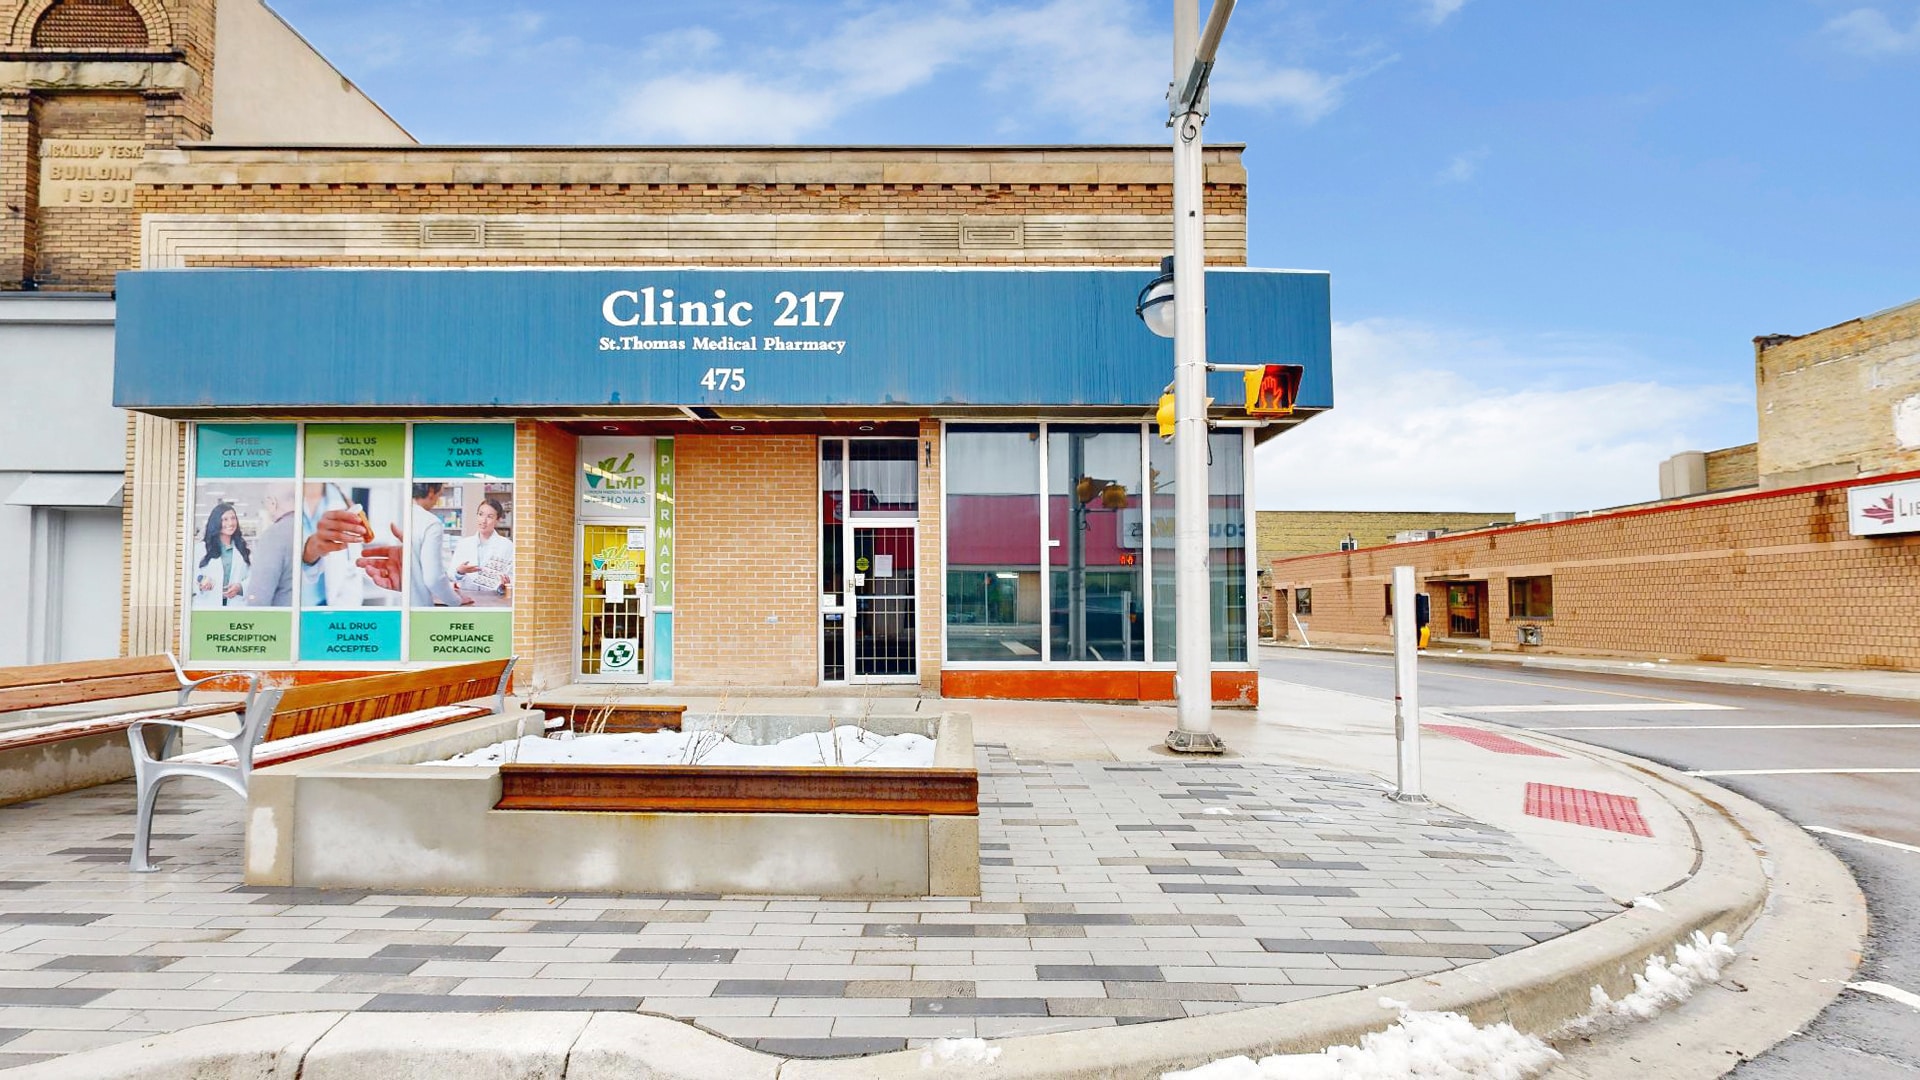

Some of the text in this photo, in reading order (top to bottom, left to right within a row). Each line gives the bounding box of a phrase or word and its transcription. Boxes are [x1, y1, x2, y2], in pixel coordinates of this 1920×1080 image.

[50, 166, 133, 181] BUILDIN
[602, 286, 845, 327] Clinic 217
[692, 336, 757, 351] Medical
[763, 336, 846, 355] Pharmacy
[700, 367, 746, 392] 475
[235, 437, 261, 445] FREE
[337, 436, 377, 444] CALL US
[451, 436, 479, 444] OPEN
[222, 448, 273, 456] CITY WIDE
[340, 447, 375, 456] TODAY!
[456, 447, 483, 456] DAYS
[223, 459, 271, 467] DELIVERY
[323, 459, 387, 467] 519-631-3300
[445, 459, 485, 467] A WEEK
[605, 476, 646, 489] LMP
[658, 455, 672, 593] PHARMACY
[229, 622, 255, 630] EASY
[328, 622, 378, 630] ALL DRUG
[449, 622, 475, 630] FREE
[206, 633, 277, 641] PRESCRIPTION
[336, 633, 369, 641] PLANS
[429, 634, 494, 642] COMPLIANCE
[216, 645, 267, 653] TRANSFER
[326, 645, 379, 653] ACCEPTED
[433, 645, 491, 653] PACKAGING
